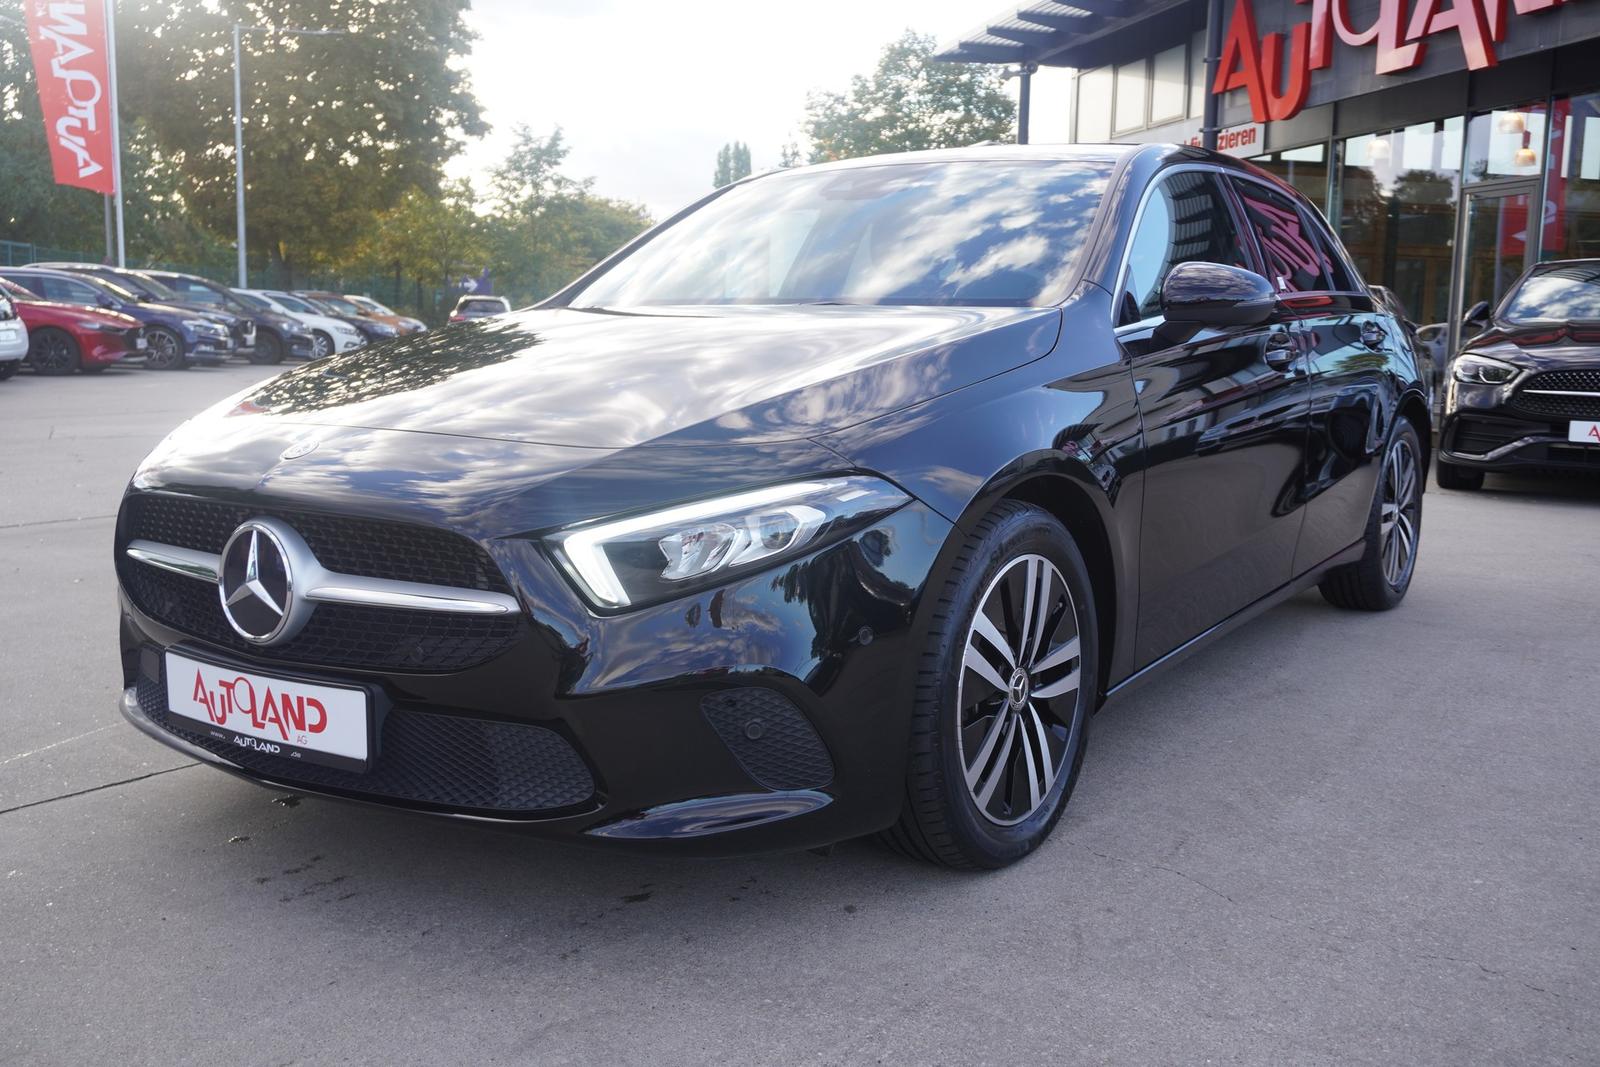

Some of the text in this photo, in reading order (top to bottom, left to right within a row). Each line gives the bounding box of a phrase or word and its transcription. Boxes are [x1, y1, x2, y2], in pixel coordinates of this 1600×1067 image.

[194, 668, 326, 740] AUTOLAND
[233, 735, 281, 754] AUTOLAND
[296, 735, 308, 745] AG
